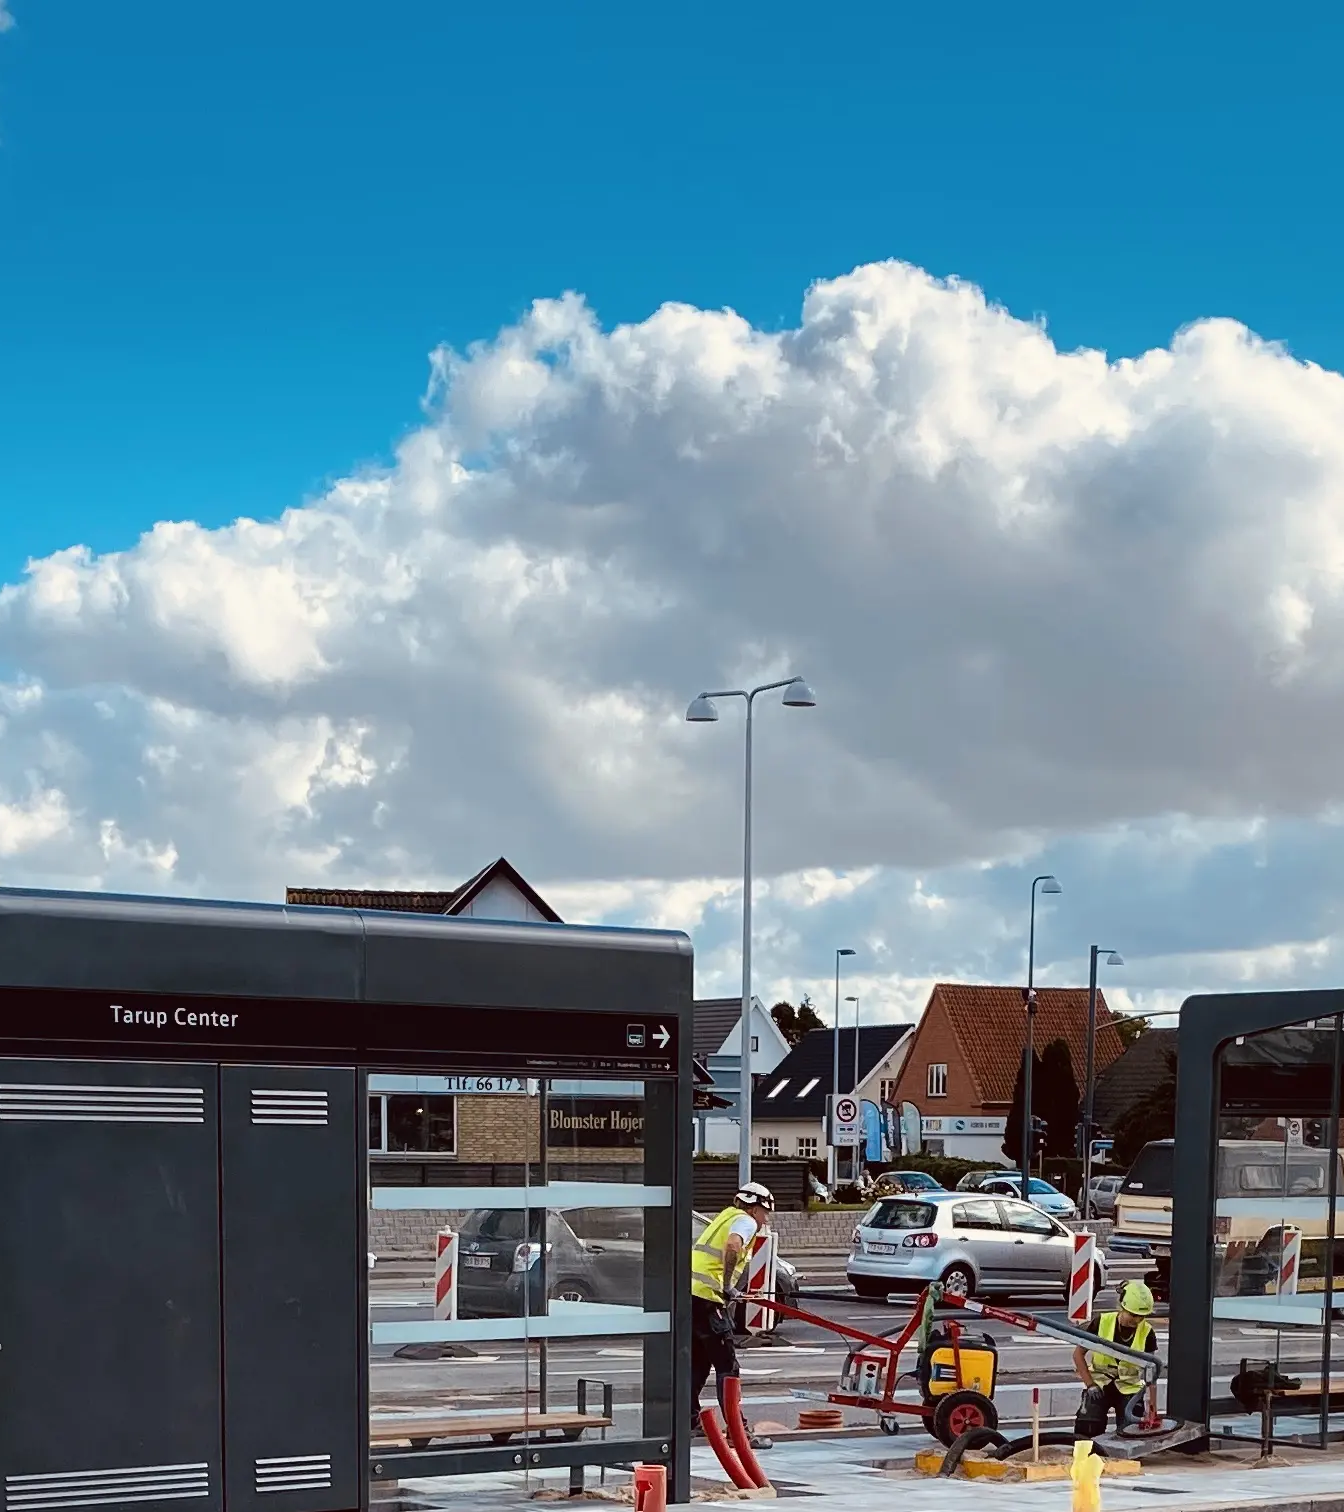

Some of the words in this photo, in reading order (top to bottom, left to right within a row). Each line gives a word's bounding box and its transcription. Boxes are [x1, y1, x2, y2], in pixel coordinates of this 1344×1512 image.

[109, 1004, 168, 1029] Tarup
[174, 1007, 239, 1027] Center
[476, 1077, 493, 1091] 66
[497, 1078, 514, 1091] 17
[549, 1109, 608, 1130] Blomster
[610, 1110, 645, 1133] Højer
